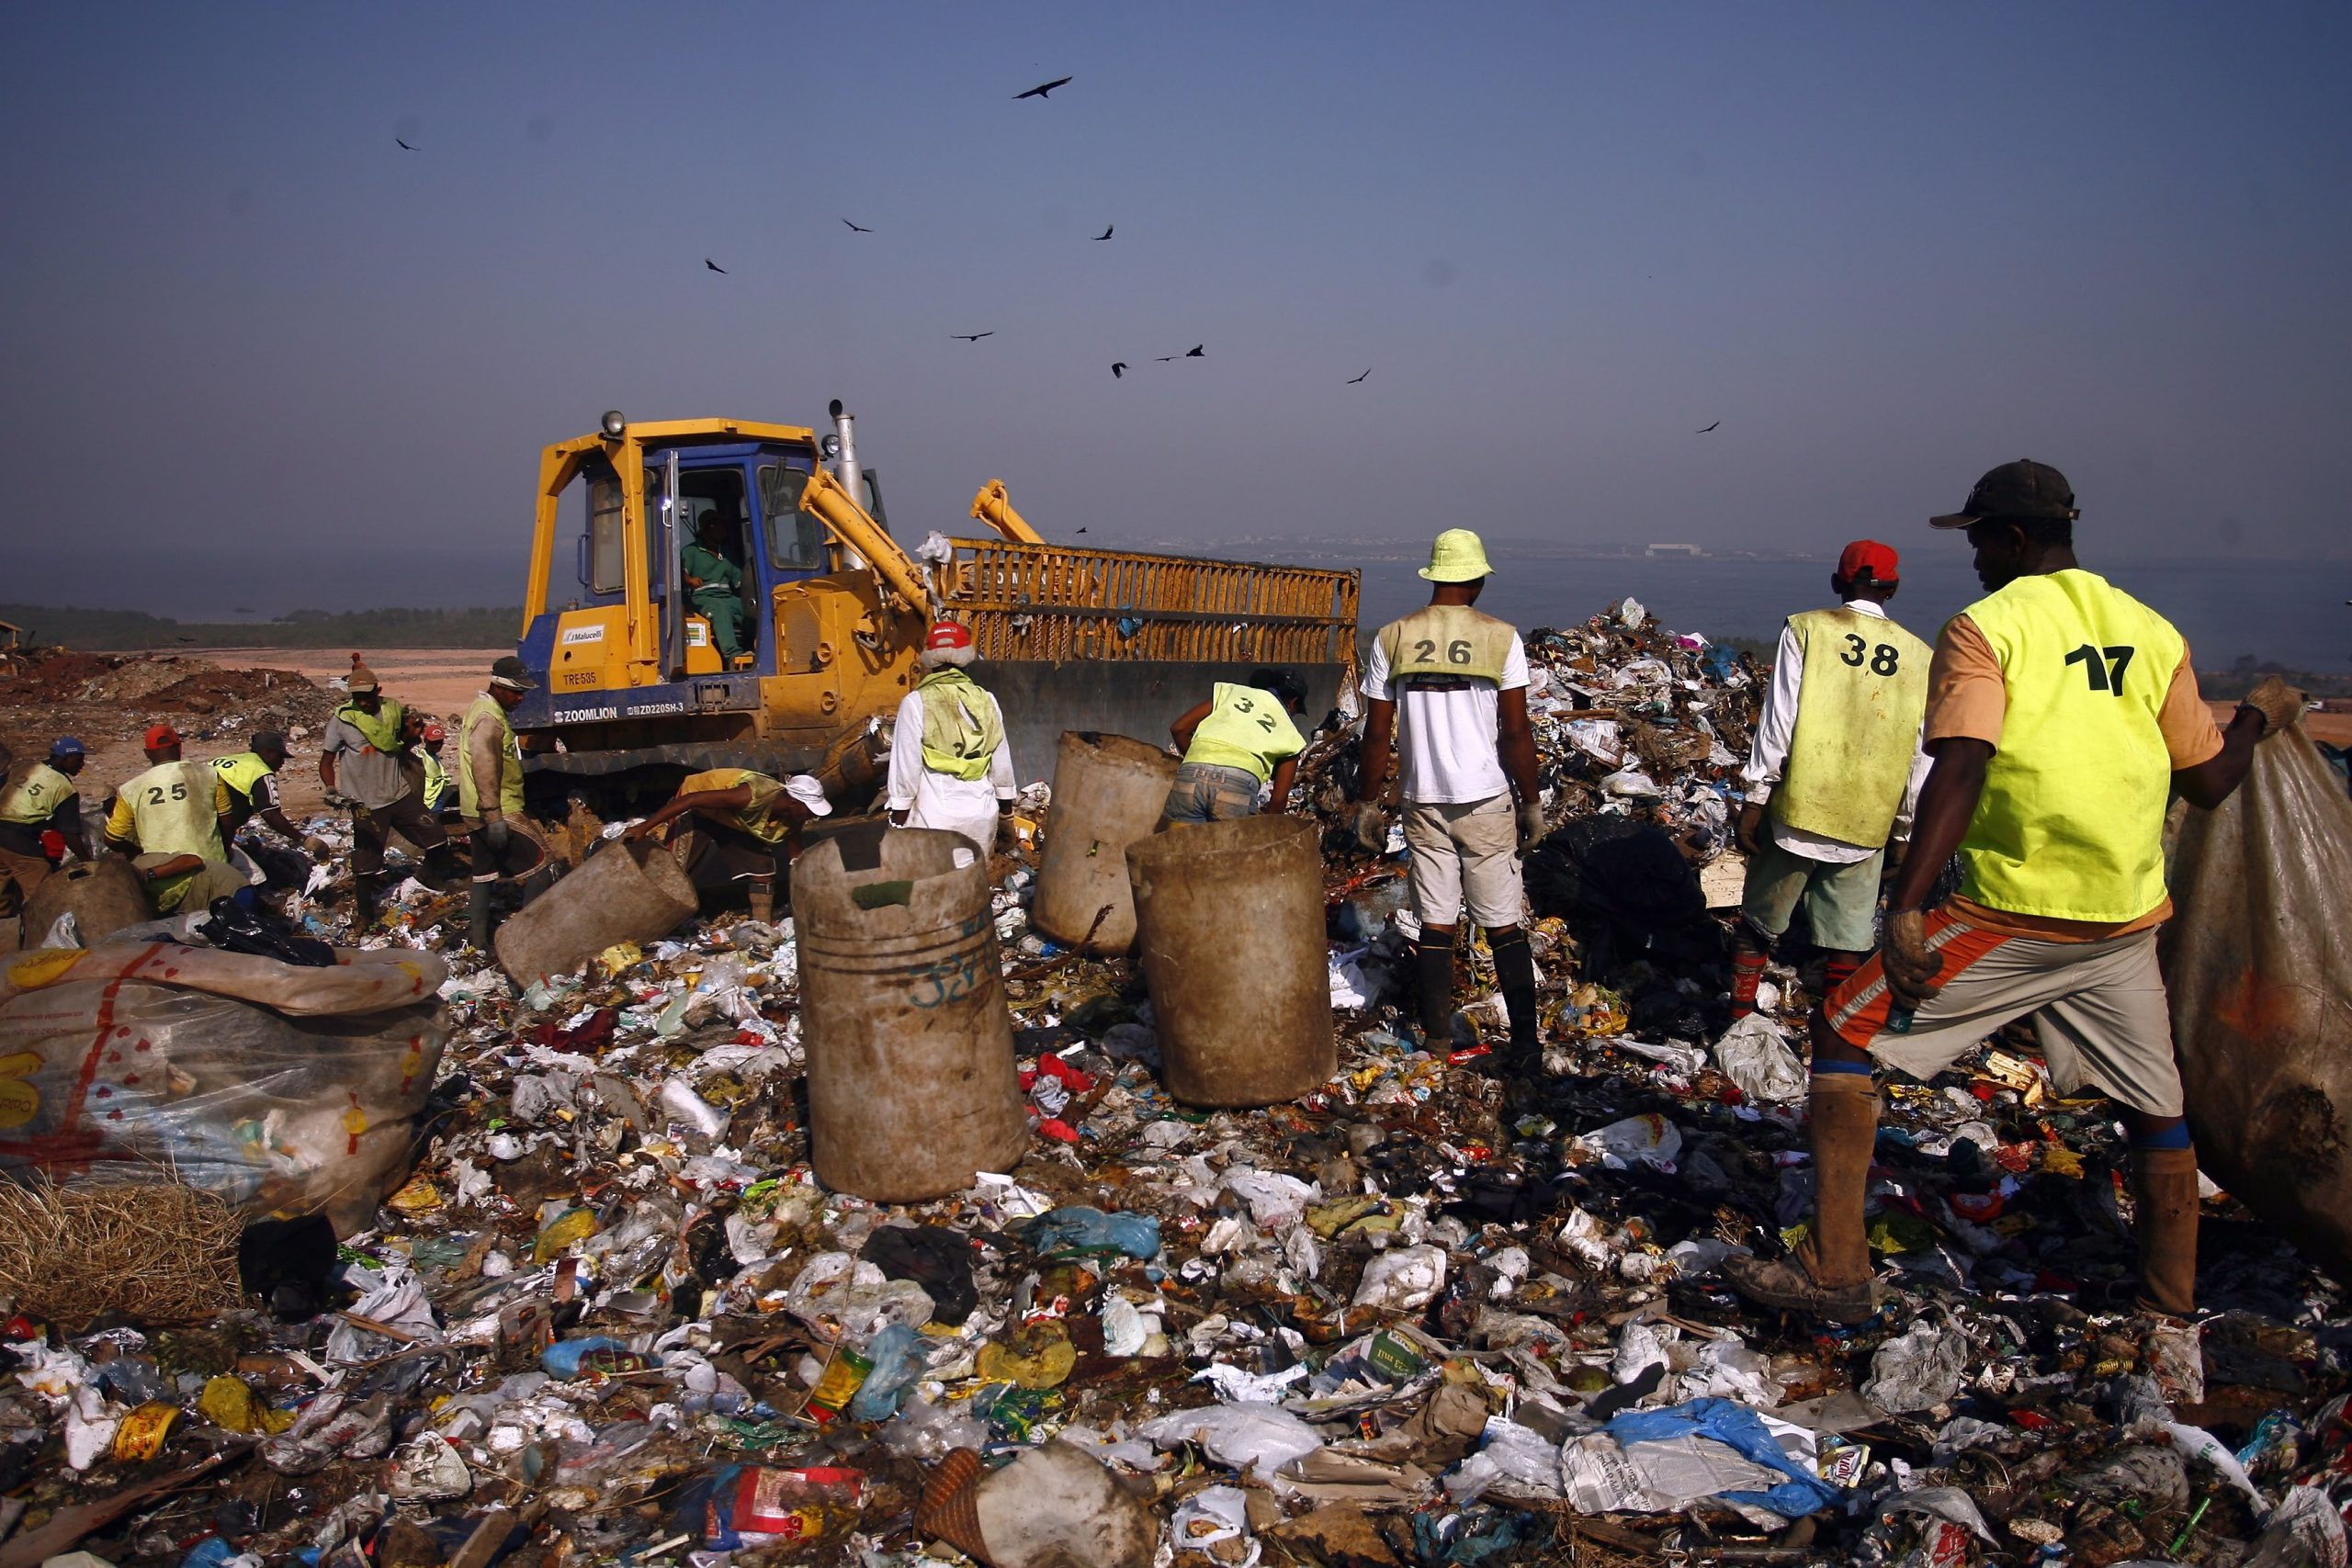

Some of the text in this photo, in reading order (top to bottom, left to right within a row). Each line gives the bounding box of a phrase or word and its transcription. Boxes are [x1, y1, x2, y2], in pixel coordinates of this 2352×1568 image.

[1414, 639, 1472, 664] 26
[1840, 633, 1899, 677] 38
[2064, 644, 2134, 696] 17
[564, 706, 617, 723] ZOOMLION
[1234, 697, 1277, 733] 32
[147, 783, 187, 805] 25
